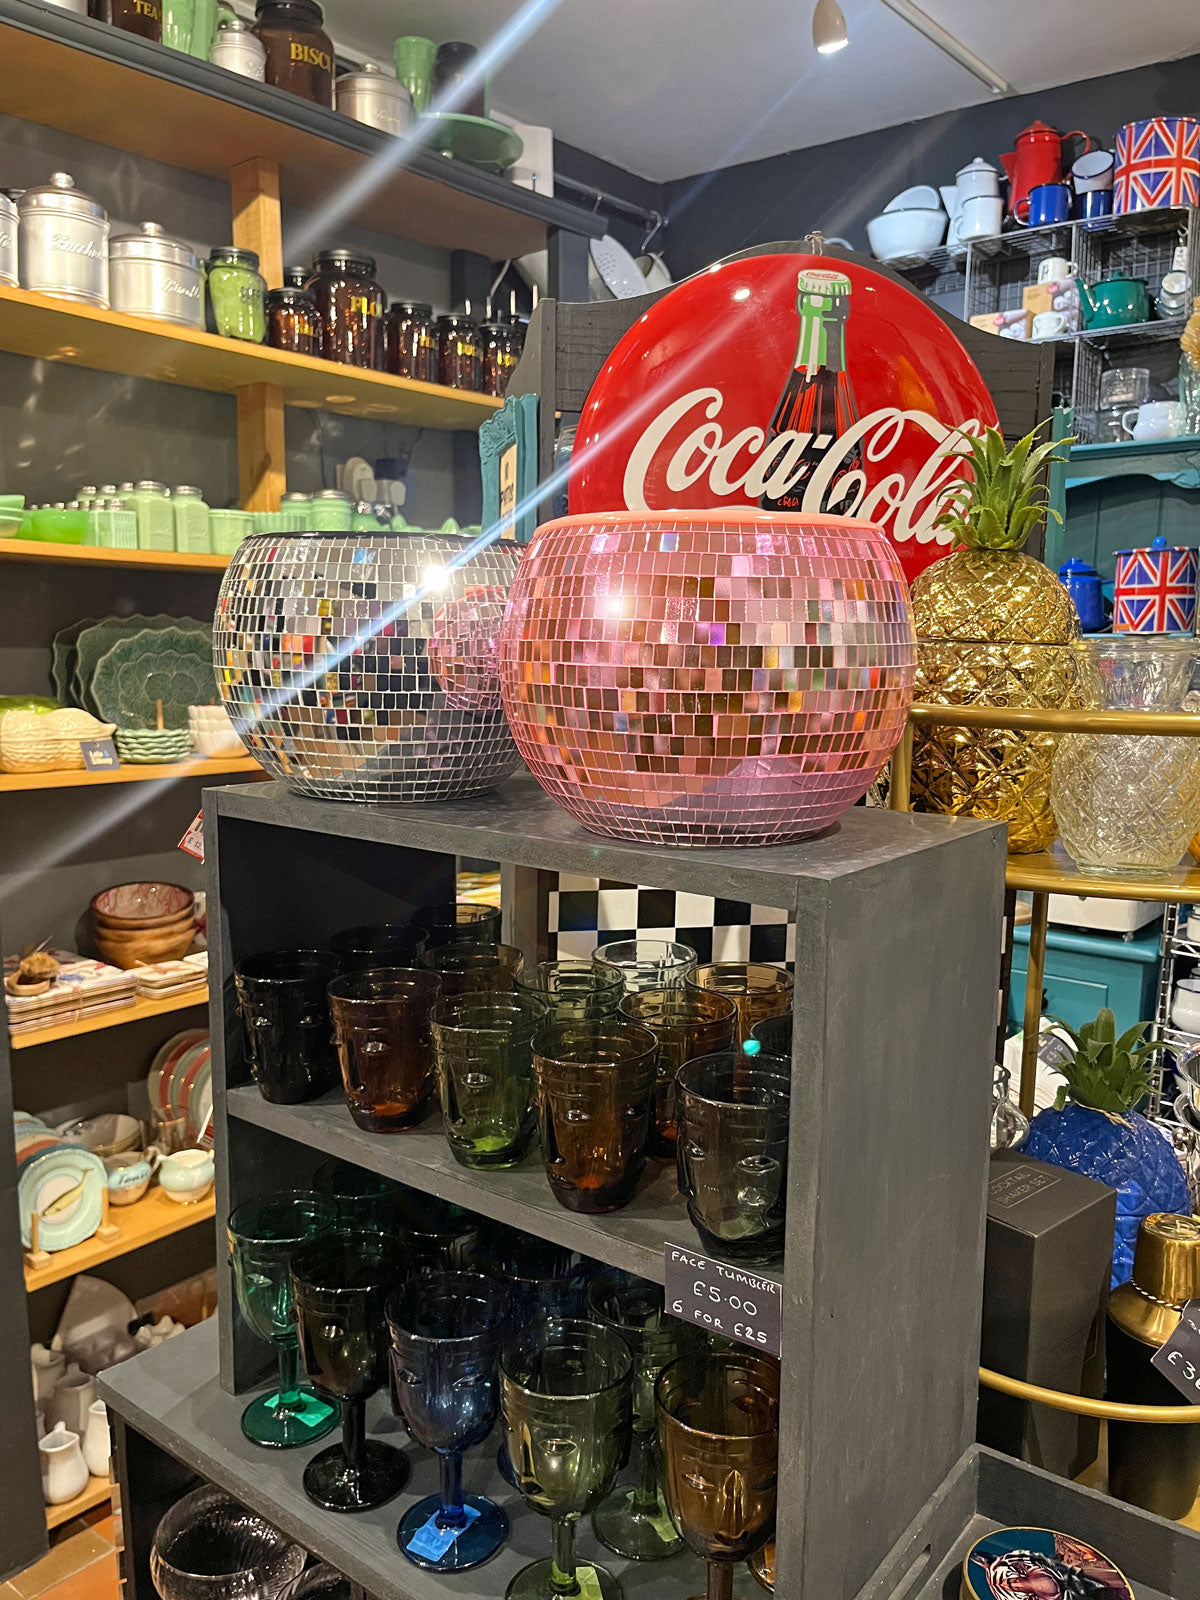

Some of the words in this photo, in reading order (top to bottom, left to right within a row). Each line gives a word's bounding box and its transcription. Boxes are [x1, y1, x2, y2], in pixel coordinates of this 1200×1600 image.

[671, 1251, 706, 1270] FACE
[715, 1265, 776, 1294] TUMBLER
[672, 1300, 683, 1313] 6
[694, 1309, 723, 1329] FOR
[733, 1322, 767, 1344] £25
